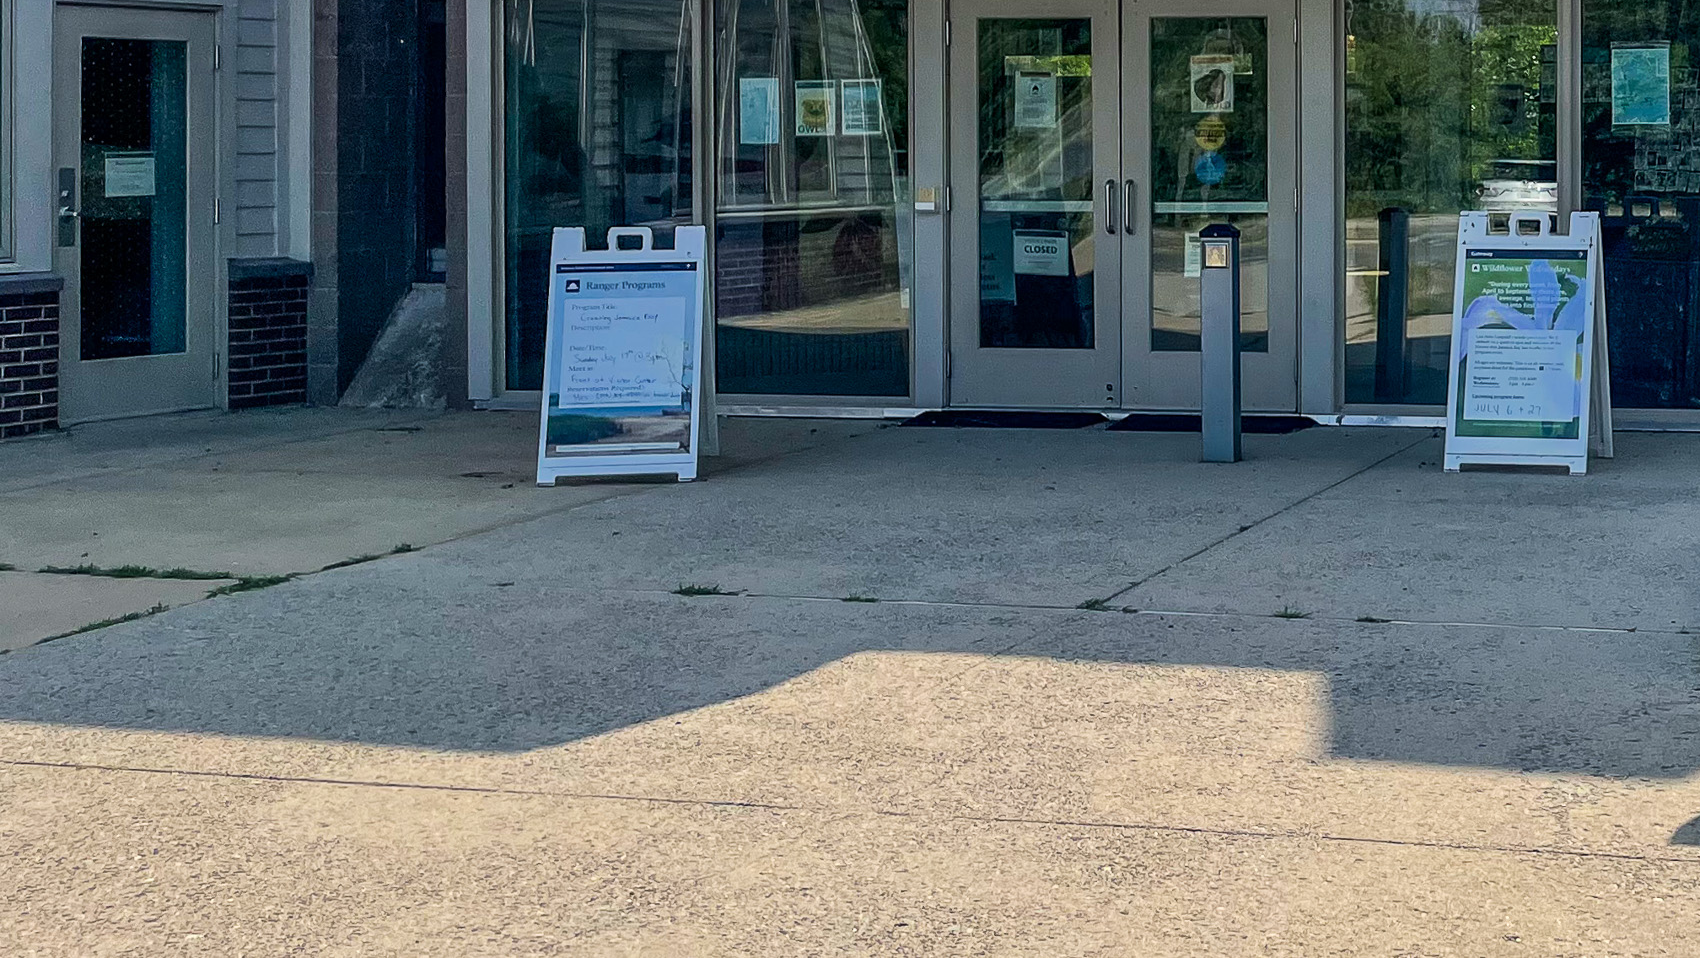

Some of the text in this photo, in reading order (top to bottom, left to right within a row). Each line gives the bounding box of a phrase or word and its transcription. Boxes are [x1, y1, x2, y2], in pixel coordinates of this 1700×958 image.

[1024, 245, 1058, 254] CLOSED
[1481, 264, 1524, 272] Wildflower
[586, 280, 666, 291] Ranger Programs
[1473, 403, 1500, 416] JULY
[1506, 404, 1513, 416] 6
[1527, 404, 1542, 416] 27
